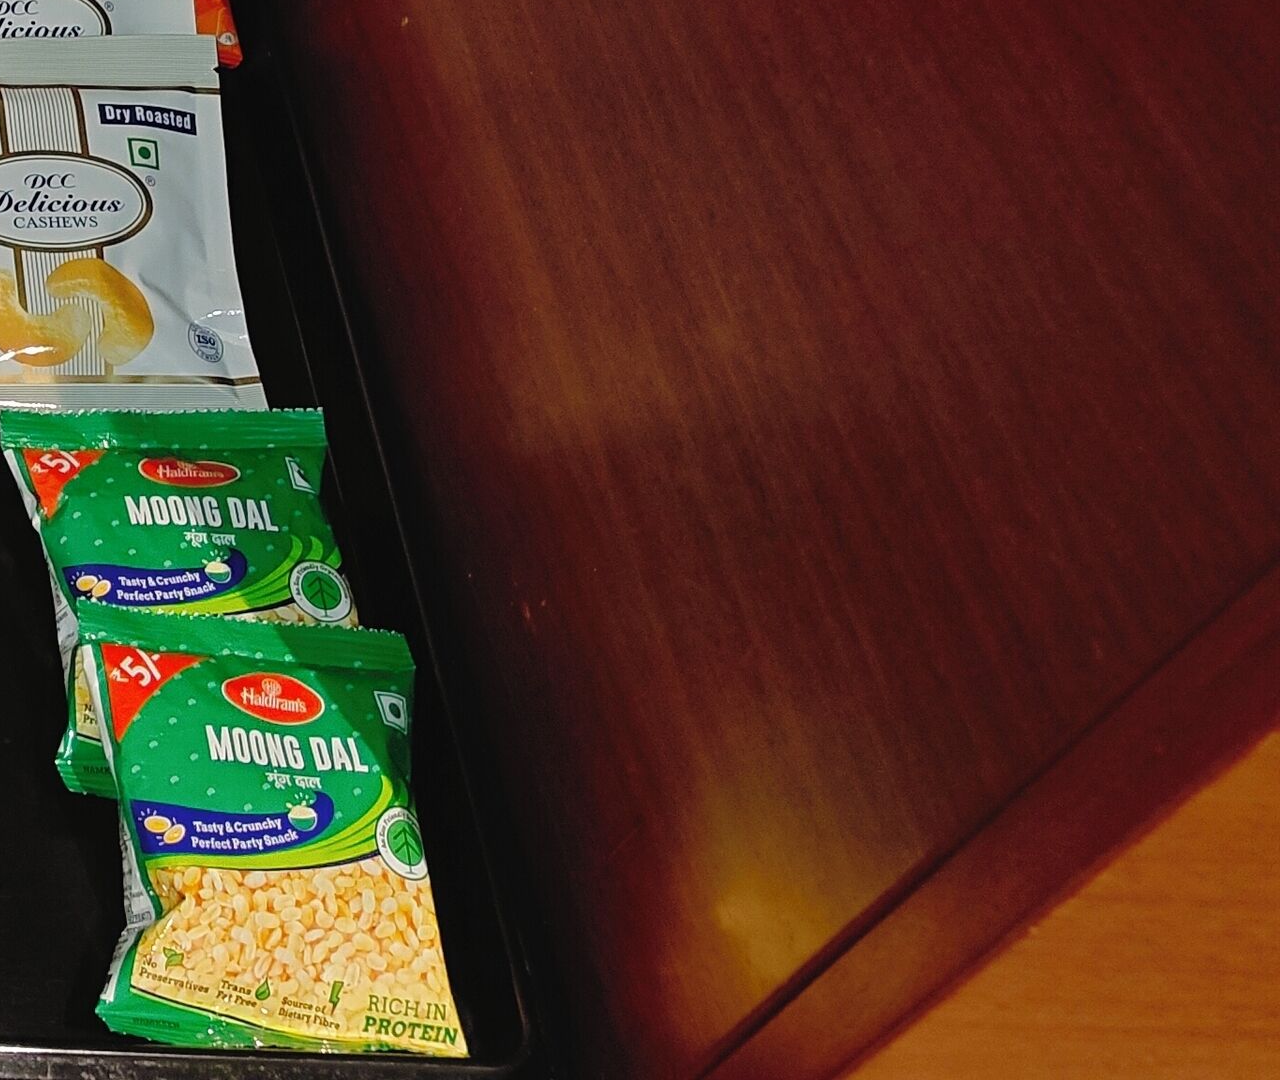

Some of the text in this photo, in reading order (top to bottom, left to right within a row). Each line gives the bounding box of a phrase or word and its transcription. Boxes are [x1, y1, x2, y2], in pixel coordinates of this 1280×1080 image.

[105, 105, 192, 131] Dry Roasted
[23, 173, 76, 190] DCC
[13, 215, 99, 229] CASHEWS
[124, 495, 280, 533] MOONG DAL
[183, 528, 236, 548] मूंग दाल
[118, 571, 201, 589] Tasty Crunchy
[116, 583, 216, 602] Perfect Party Snack
[240, 687, 307, 713] Haldiram's
[205, 725, 369, 773] MOONG DAL
[265, 769, 322, 790] मूंग दाल
[192, 816, 282, 836] Tasty Crunchy
[191, 829, 300, 852] Perfect Party Snack
[142, 956, 158, 969] No
[139, 967, 210, 994] Preservatives
[221, 979, 252, 996] Trans
[234, 994, 258, 1008] Free
[281, 996, 314, 1011] Source
[368, 994, 447, 1021] RICH IN
[278, 1008, 341, 1030] Dietary Fibre
[361, 1016, 459, 1046] PROTEIN
